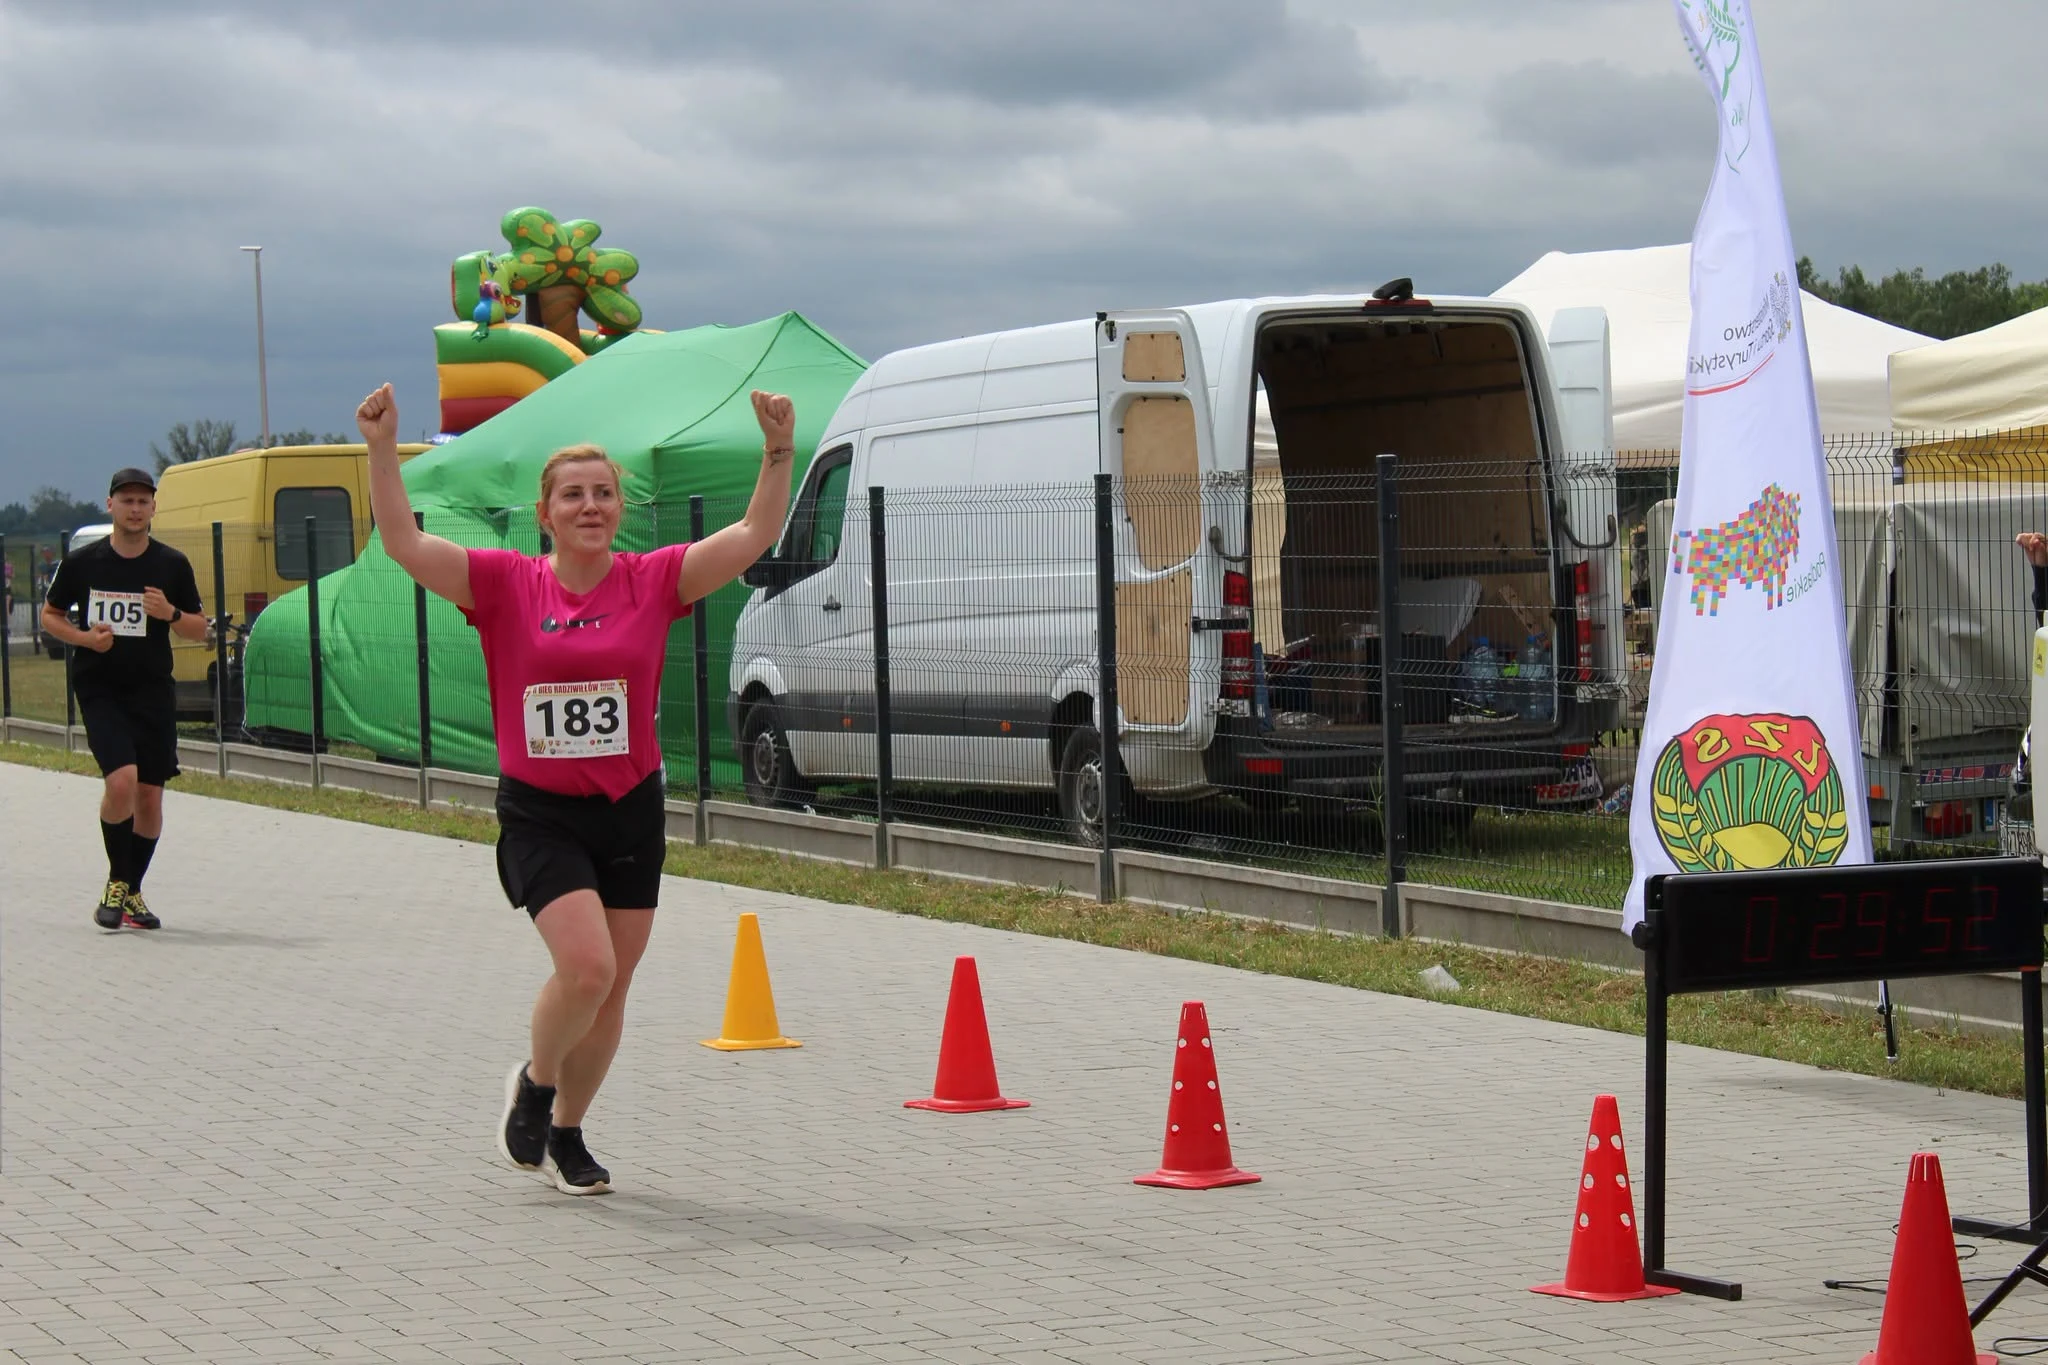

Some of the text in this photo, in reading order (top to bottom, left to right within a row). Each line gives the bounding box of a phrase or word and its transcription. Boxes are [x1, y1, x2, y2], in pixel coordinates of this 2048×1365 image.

[95, 601, 142, 624] 105
[550, 618, 600, 628] NIKE
[536, 696, 619, 737] 183
